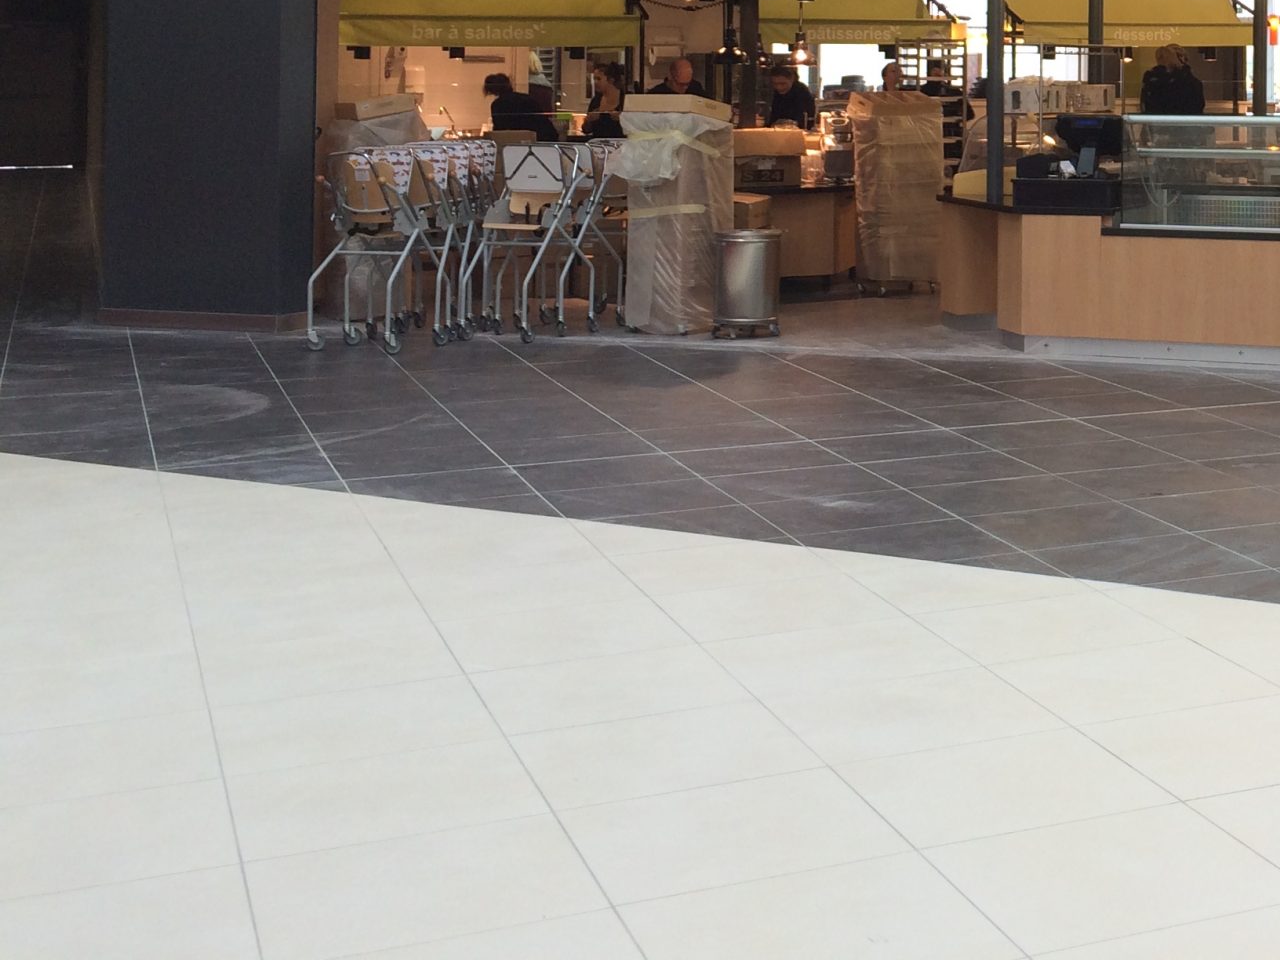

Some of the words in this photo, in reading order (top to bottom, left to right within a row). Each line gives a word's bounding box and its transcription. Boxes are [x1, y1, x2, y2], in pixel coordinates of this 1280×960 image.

[411, 24, 443, 40] bar
[447, 24, 459, 40] à
[463, 24, 535, 40] salades
[1112, 28, 1172, 41] desserts
